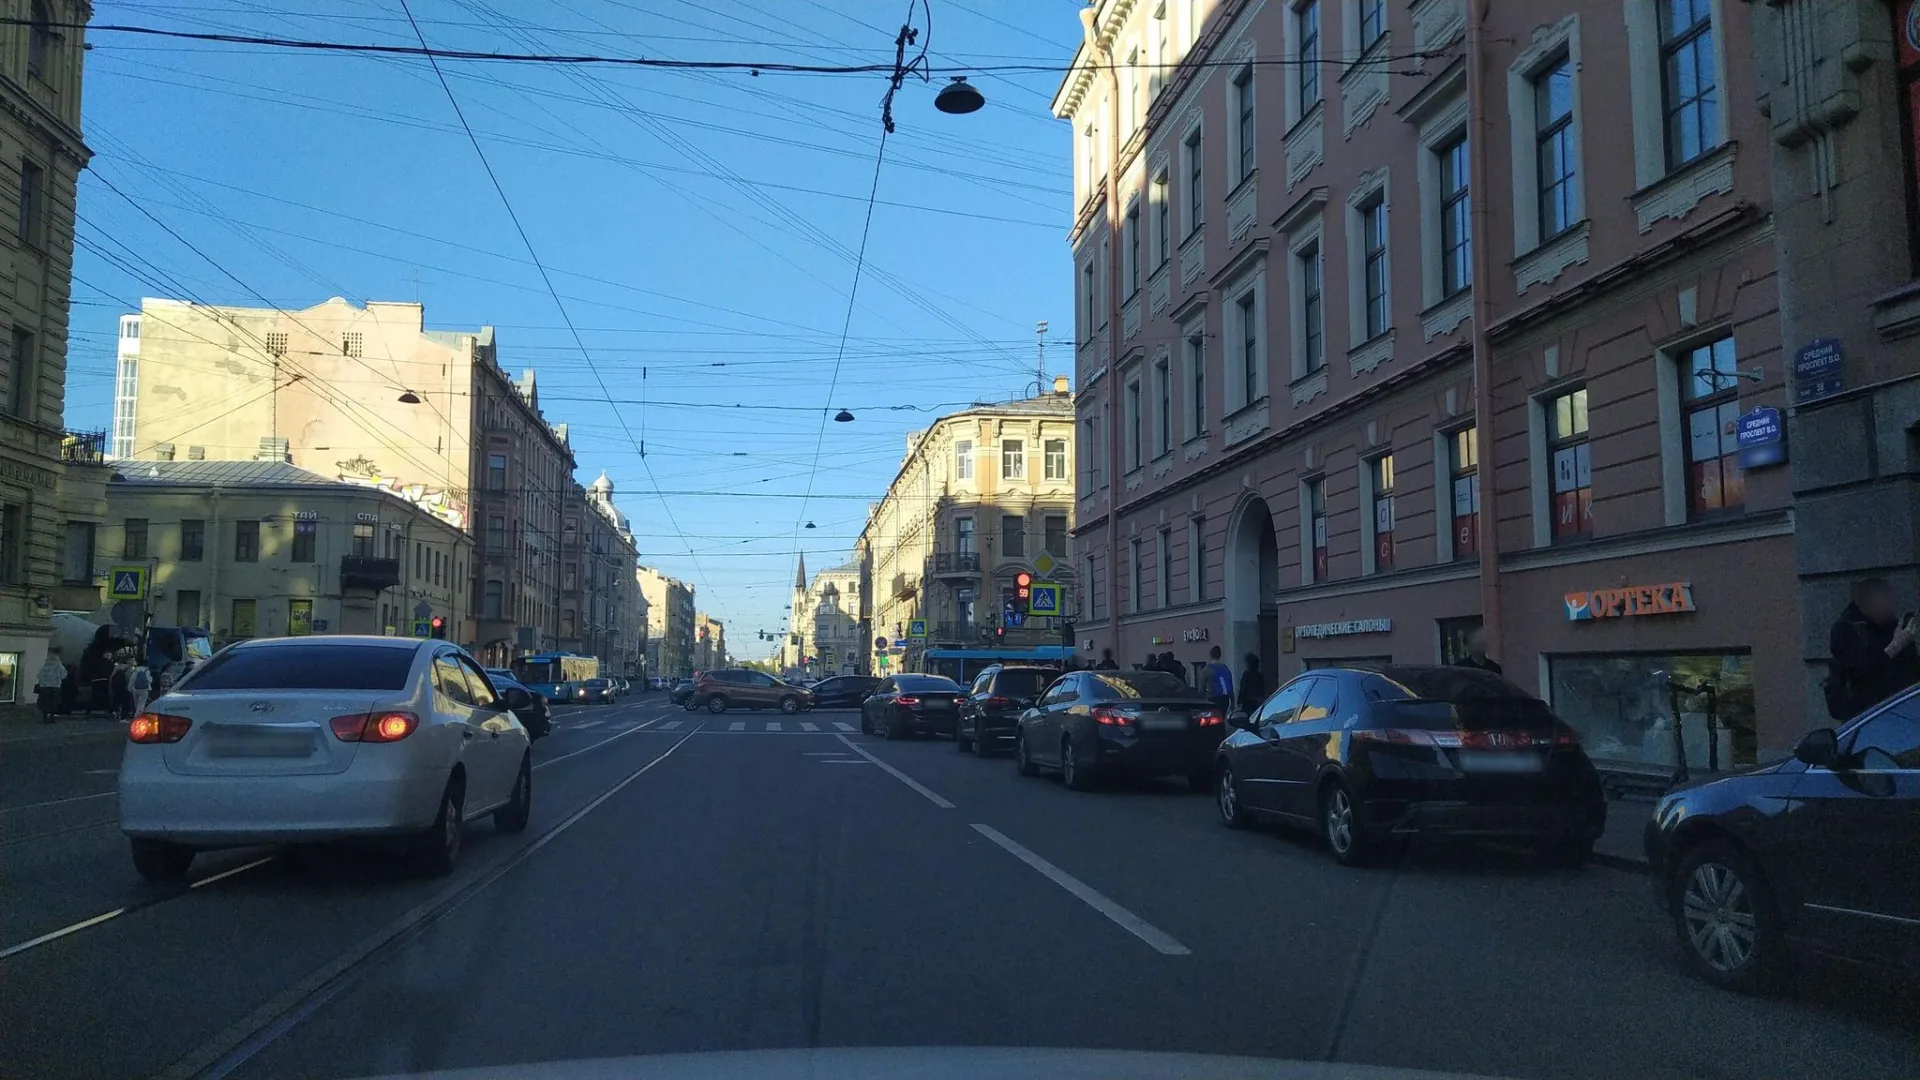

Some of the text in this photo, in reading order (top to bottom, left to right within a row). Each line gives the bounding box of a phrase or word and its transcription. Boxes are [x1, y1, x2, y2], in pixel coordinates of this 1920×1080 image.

[1803, 344, 1833, 361] СРЕДНИЙ
[1797, 356, 1828, 373] ПРОСПЕКТ
[1746, 416, 1770, 429] СРЕДНИЙ
[1740, 427, 1766, 440] ПРОСПЕКТ
[293, 510, 317, 520] ТАЙ
[356, 512, 379, 523] СПА
[1589, 582, 1691, 618] ОРТЕКА
[1295, 618, 1391, 639] ОРТОПЕДИЧЕСКИЕ САЛОНЫ
